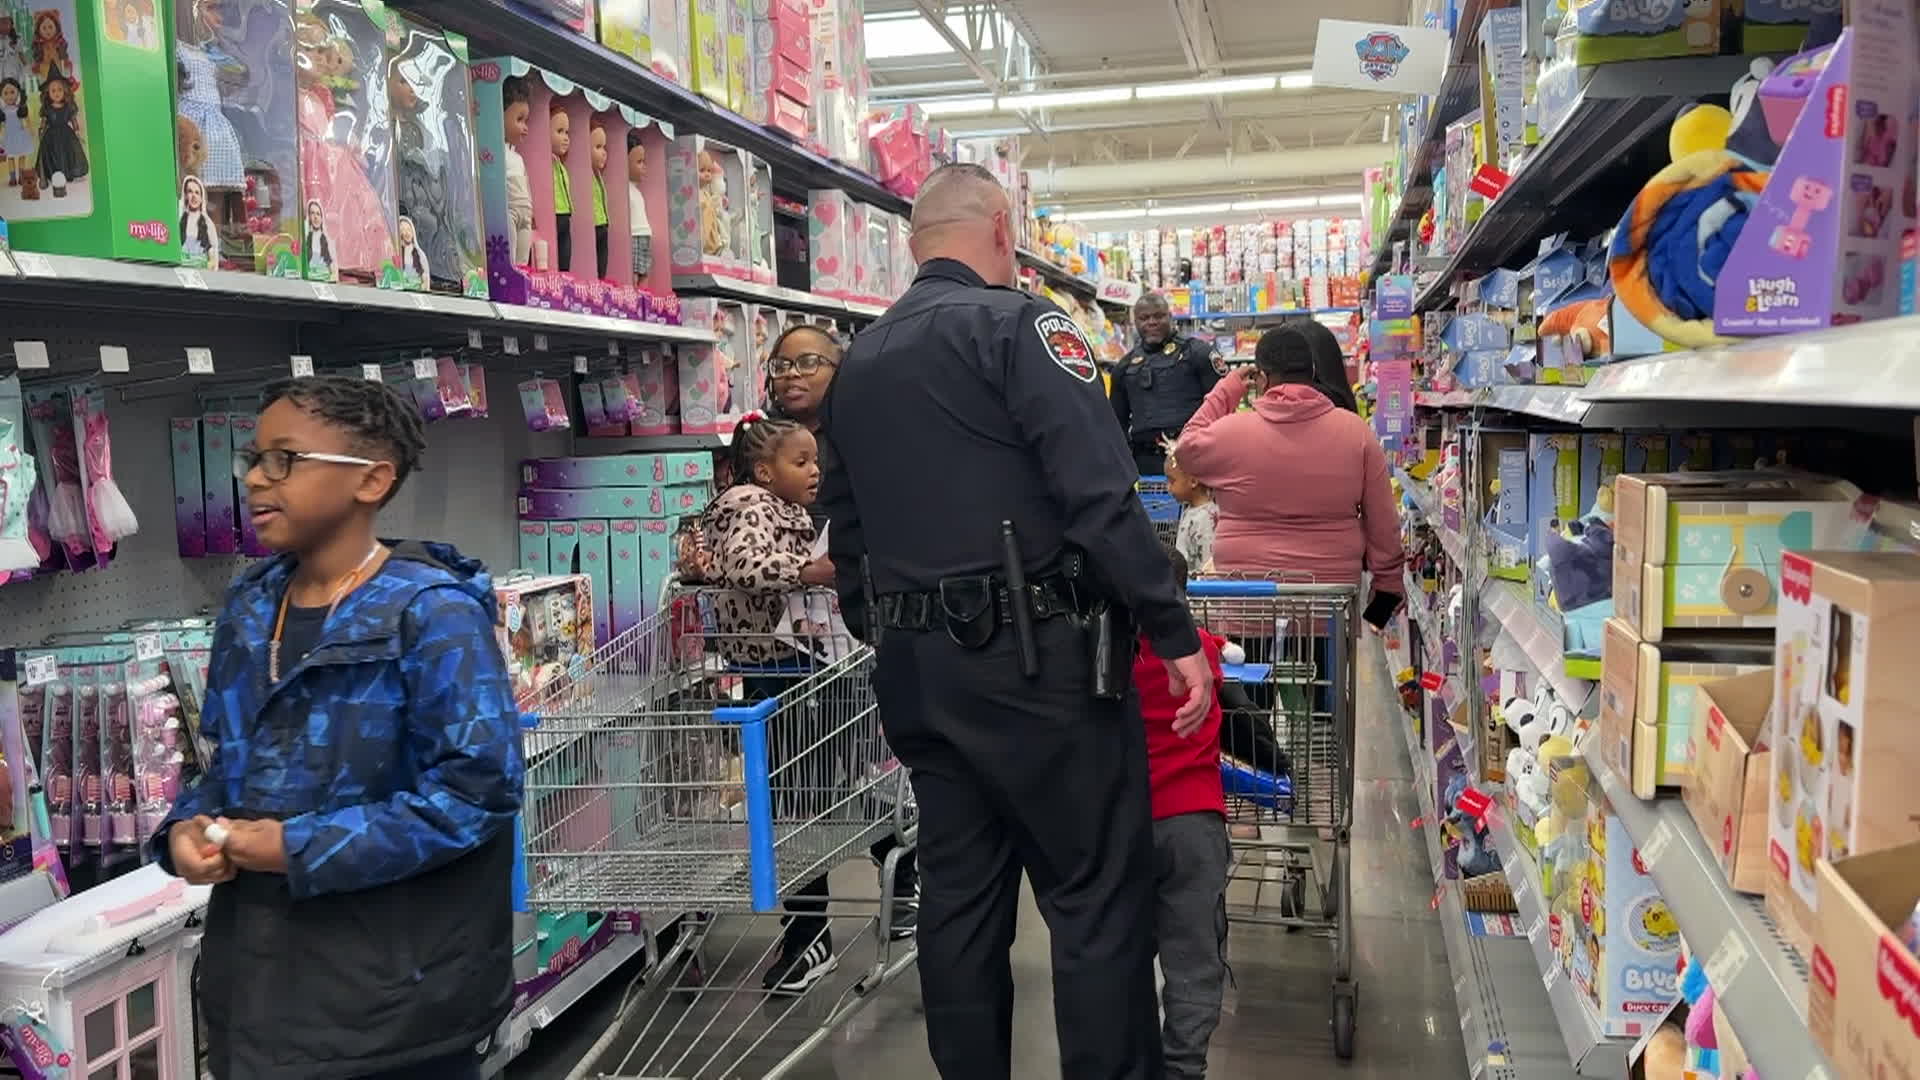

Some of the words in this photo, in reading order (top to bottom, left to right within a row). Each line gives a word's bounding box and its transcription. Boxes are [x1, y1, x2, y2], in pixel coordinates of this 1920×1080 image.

[1748, 276, 1796, 297] Laugh
[1757, 294, 1799, 312] Learn
[1040, 318, 1082, 341] POLICE
